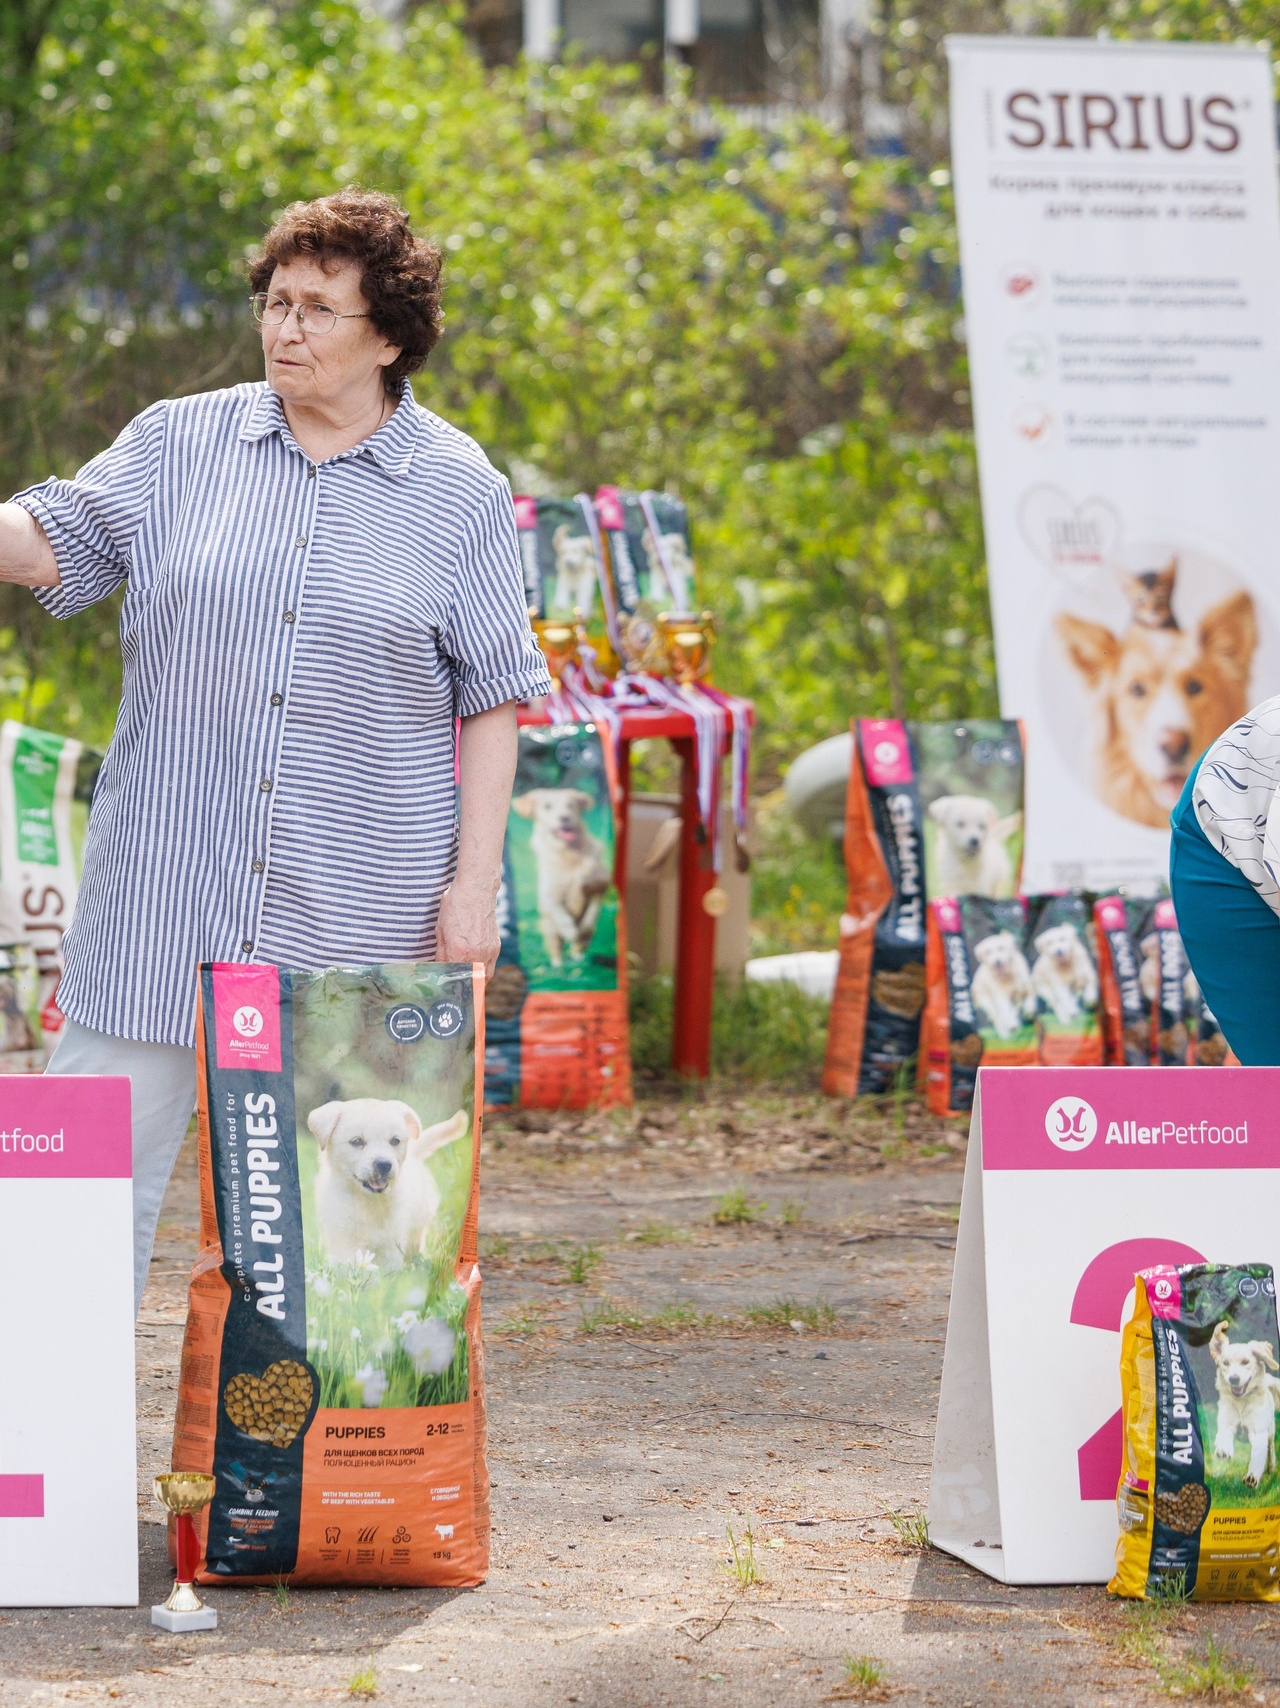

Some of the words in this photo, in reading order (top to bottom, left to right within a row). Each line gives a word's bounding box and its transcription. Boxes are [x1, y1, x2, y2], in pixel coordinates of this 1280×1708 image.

[1006, 91, 1240, 153] SIRIUS
[229, 1039, 270, 1050] AllerPetfood
[227, 1092, 235, 1112] for
[228, 1116, 237, 1147] food
[1104, 1120, 1248, 1145] AllerPetfood
[231, 1154, 241, 1174] pet
[244, 1092, 283, 1245] PUPPIES
[232, 1180, 243, 1237] premium
[253, 1252, 286, 1321] ALL
[1165, 1327, 1192, 1419] PUPPIES
[325, 1427, 386, 1439] PUPPIES
[427, 1423, 449, 1436] 2-12
[324, 1449, 342, 1458] ДЛЯ
[343, 1449, 377, 1458] ЩЕНКОВ
[378, 1448, 398, 1457] ВСЕХ
[399, 1447, 424, 1456] ПОРОД
[1172, 1422, 1193, 1465] ALL
[324, 1458, 384, 1467] ПОЛНОЦЕННЫЙ
[385, 1458, 416, 1467] РАЦИОН
[361, 1497, 395, 1505] VEGETABLES
[228, 1507, 253, 1516] COMBINE
[255, 1509, 279, 1517] FEEDING
[1213, 1516, 1247, 1525] PUPPIES
[443, 1551, 451, 1559] kg
